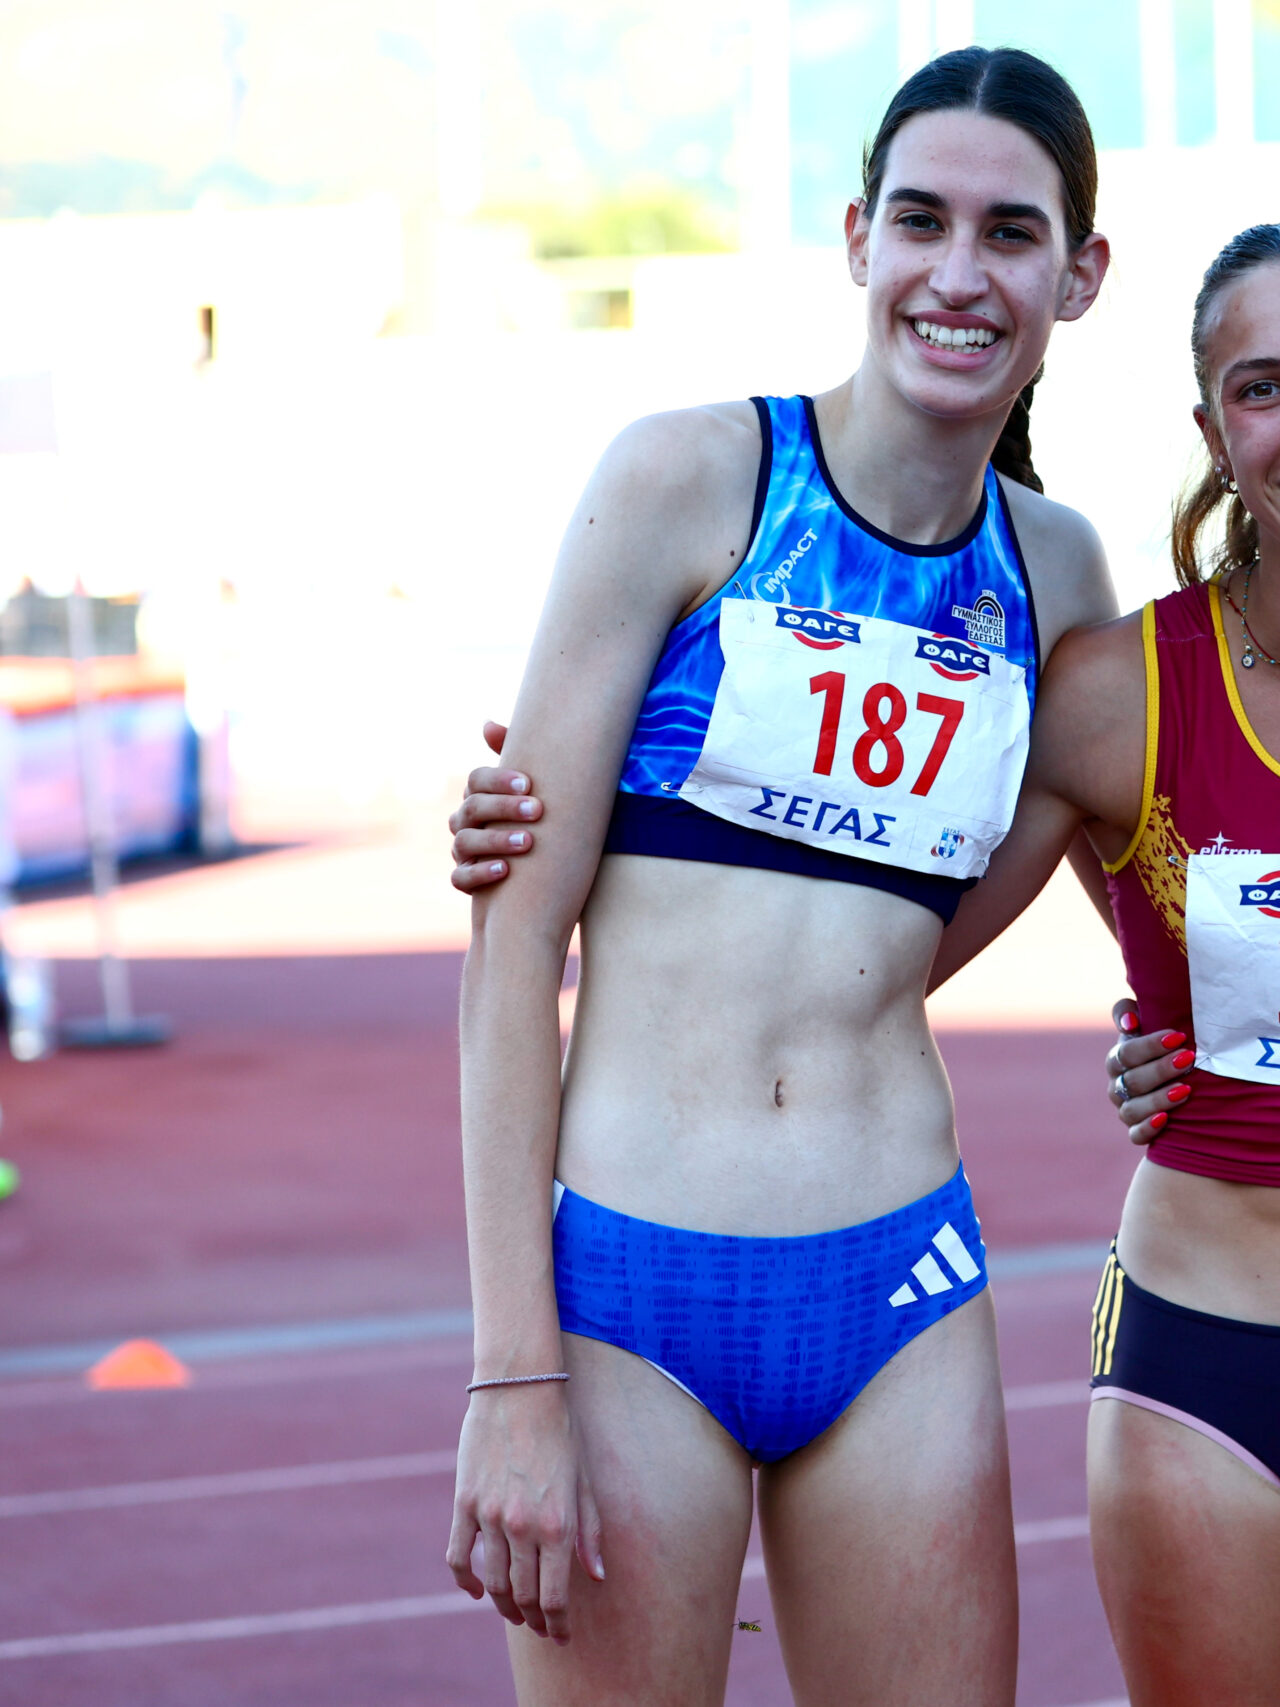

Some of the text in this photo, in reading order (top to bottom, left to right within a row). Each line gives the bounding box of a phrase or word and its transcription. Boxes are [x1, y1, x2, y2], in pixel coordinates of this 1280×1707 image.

[764, 528, 818, 594] IMPACT
[952, 606, 1004, 628] ΓΥΜΝΑΣΤΙΚΟΣ
[966, 620, 1004, 637] ΣΥΛΛΟΓΟΣ
[969, 630, 1004, 647] ΕΔΕΣΣΑΣ
[809, 670, 965, 797] 187
[748, 787, 896, 848] ΣΕΓΑΣ
